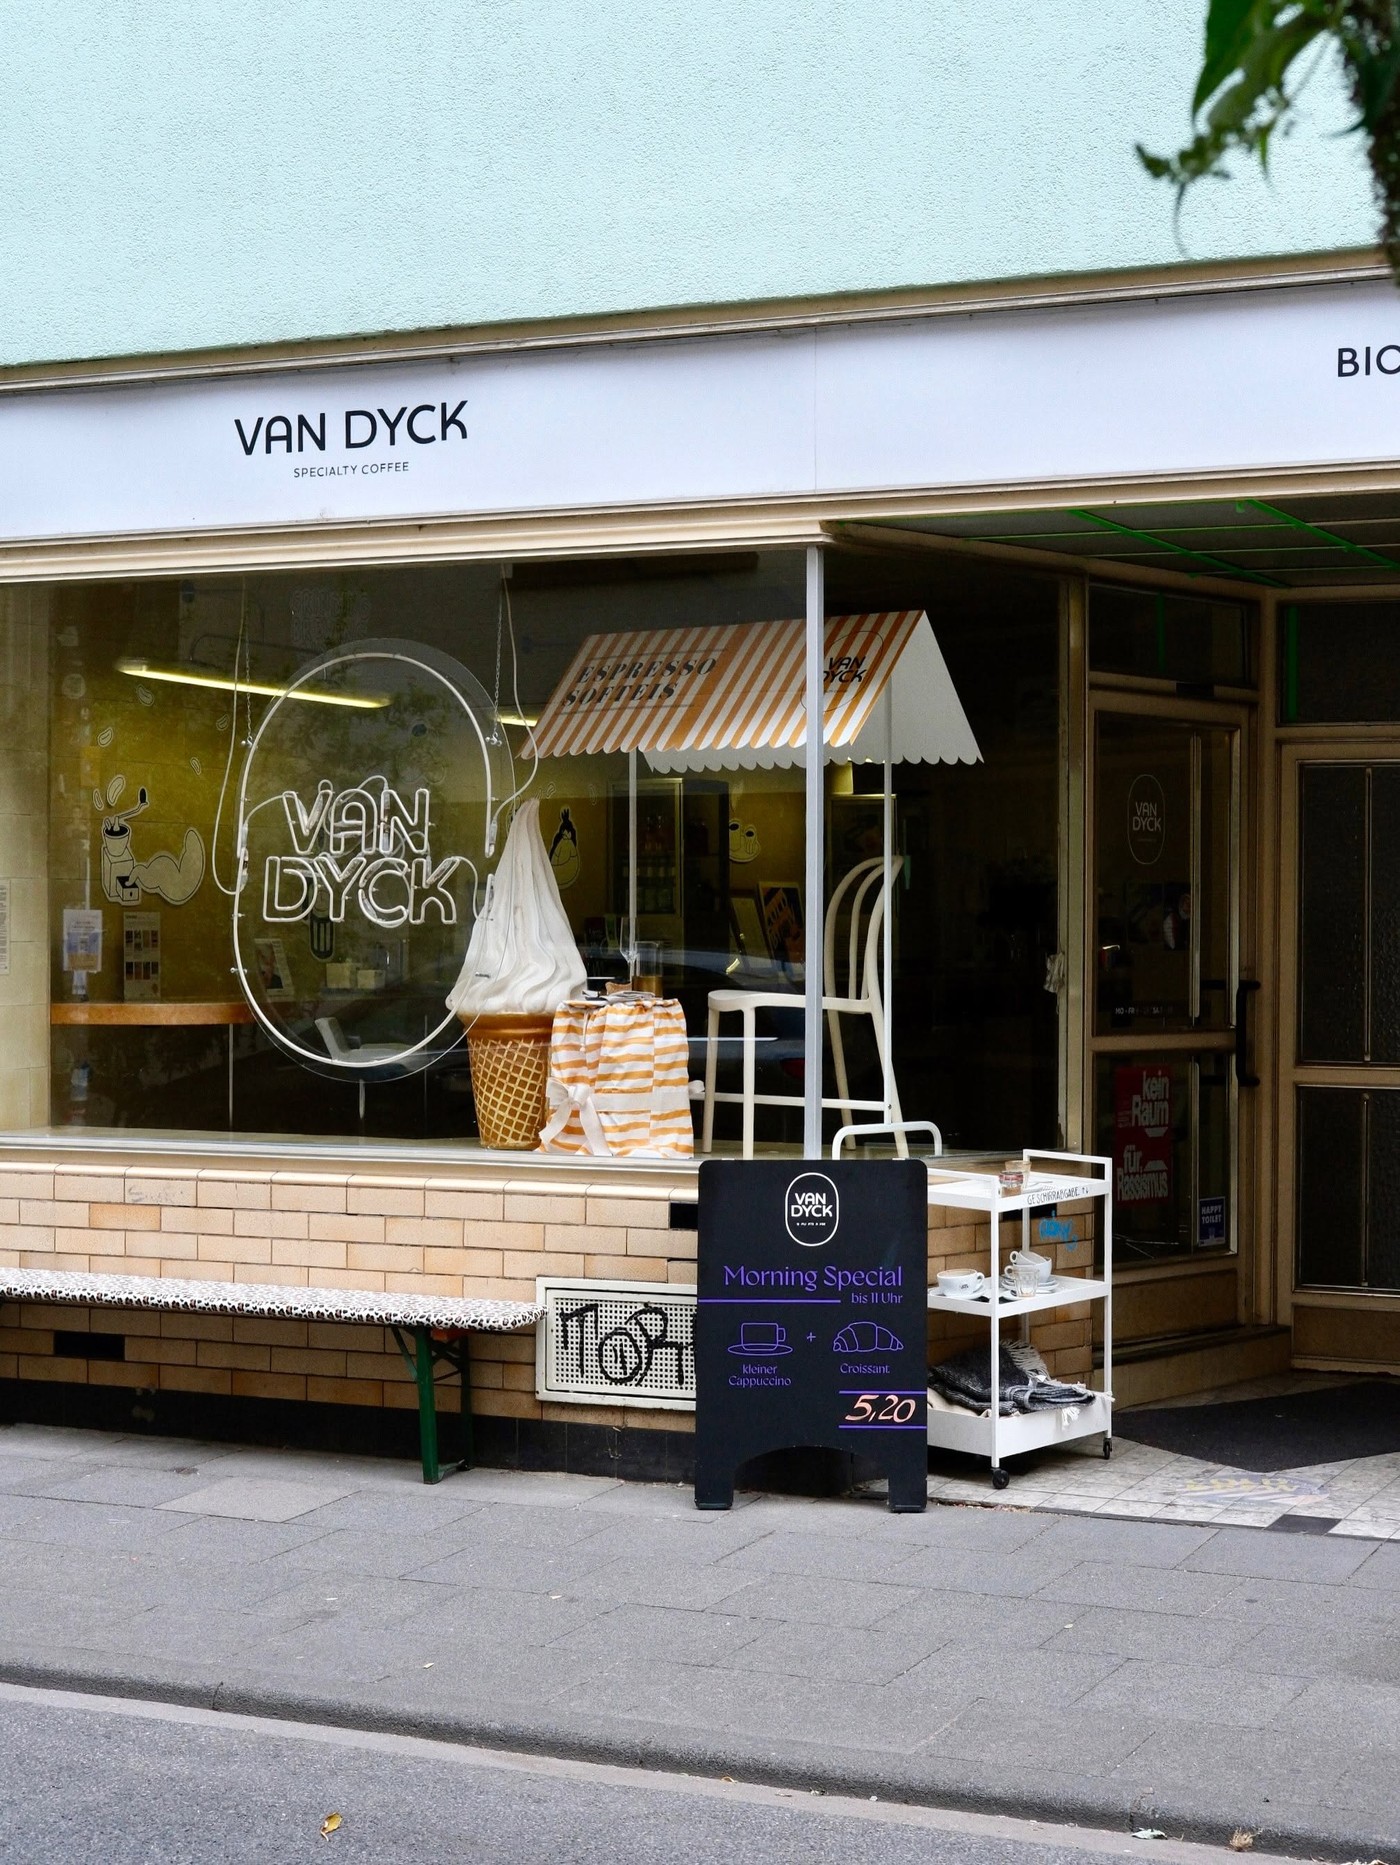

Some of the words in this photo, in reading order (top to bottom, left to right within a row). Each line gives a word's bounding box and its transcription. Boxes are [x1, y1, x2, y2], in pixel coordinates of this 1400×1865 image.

[234, 412, 326, 456] VAN
[345, 400, 468, 449] DYCK
[293, 465, 358, 478] SPECIALTY
[361, 461, 410, 475] COFFEE
[577, 658, 717, 684] ESPRESSO
[829, 655, 866, 670] VAN
[563, 682, 678, 707] SOFTEIS
[1135, 802, 1158, 816] VAN
[282, 788, 430, 854] VAN
[1132, 816, 1161, 831] DYCK
[263, 855, 461, 928] DYCK
[1142, 1070, 1169, 1100] kein
[1131, 1094, 1169, 1127] Raum
[1123, 1145, 1142, 1172] für
[1117, 1167, 1168, 1200] Rassismus
[794, 1192, 827, 1205] VAN
[791, 1205, 833, 1217] DYCK
[1201, 1204, 1222, 1215] HAPPY
[1201, 1214, 1222, 1224] TOILET
[723, 1265, 818, 1292] Morning
[823, 1265, 902, 1291] Special
[851, 1292, 868, 1304] bis
[881, 1292, 903, 1304] Uhr
[742, 1363, 778, 1375] kleiner
[839, 1363, 890, 1374] Croissant
[728, 1376, 792, 1388] Cappuccino
[845, 1394, 916, 1423] 5,20
